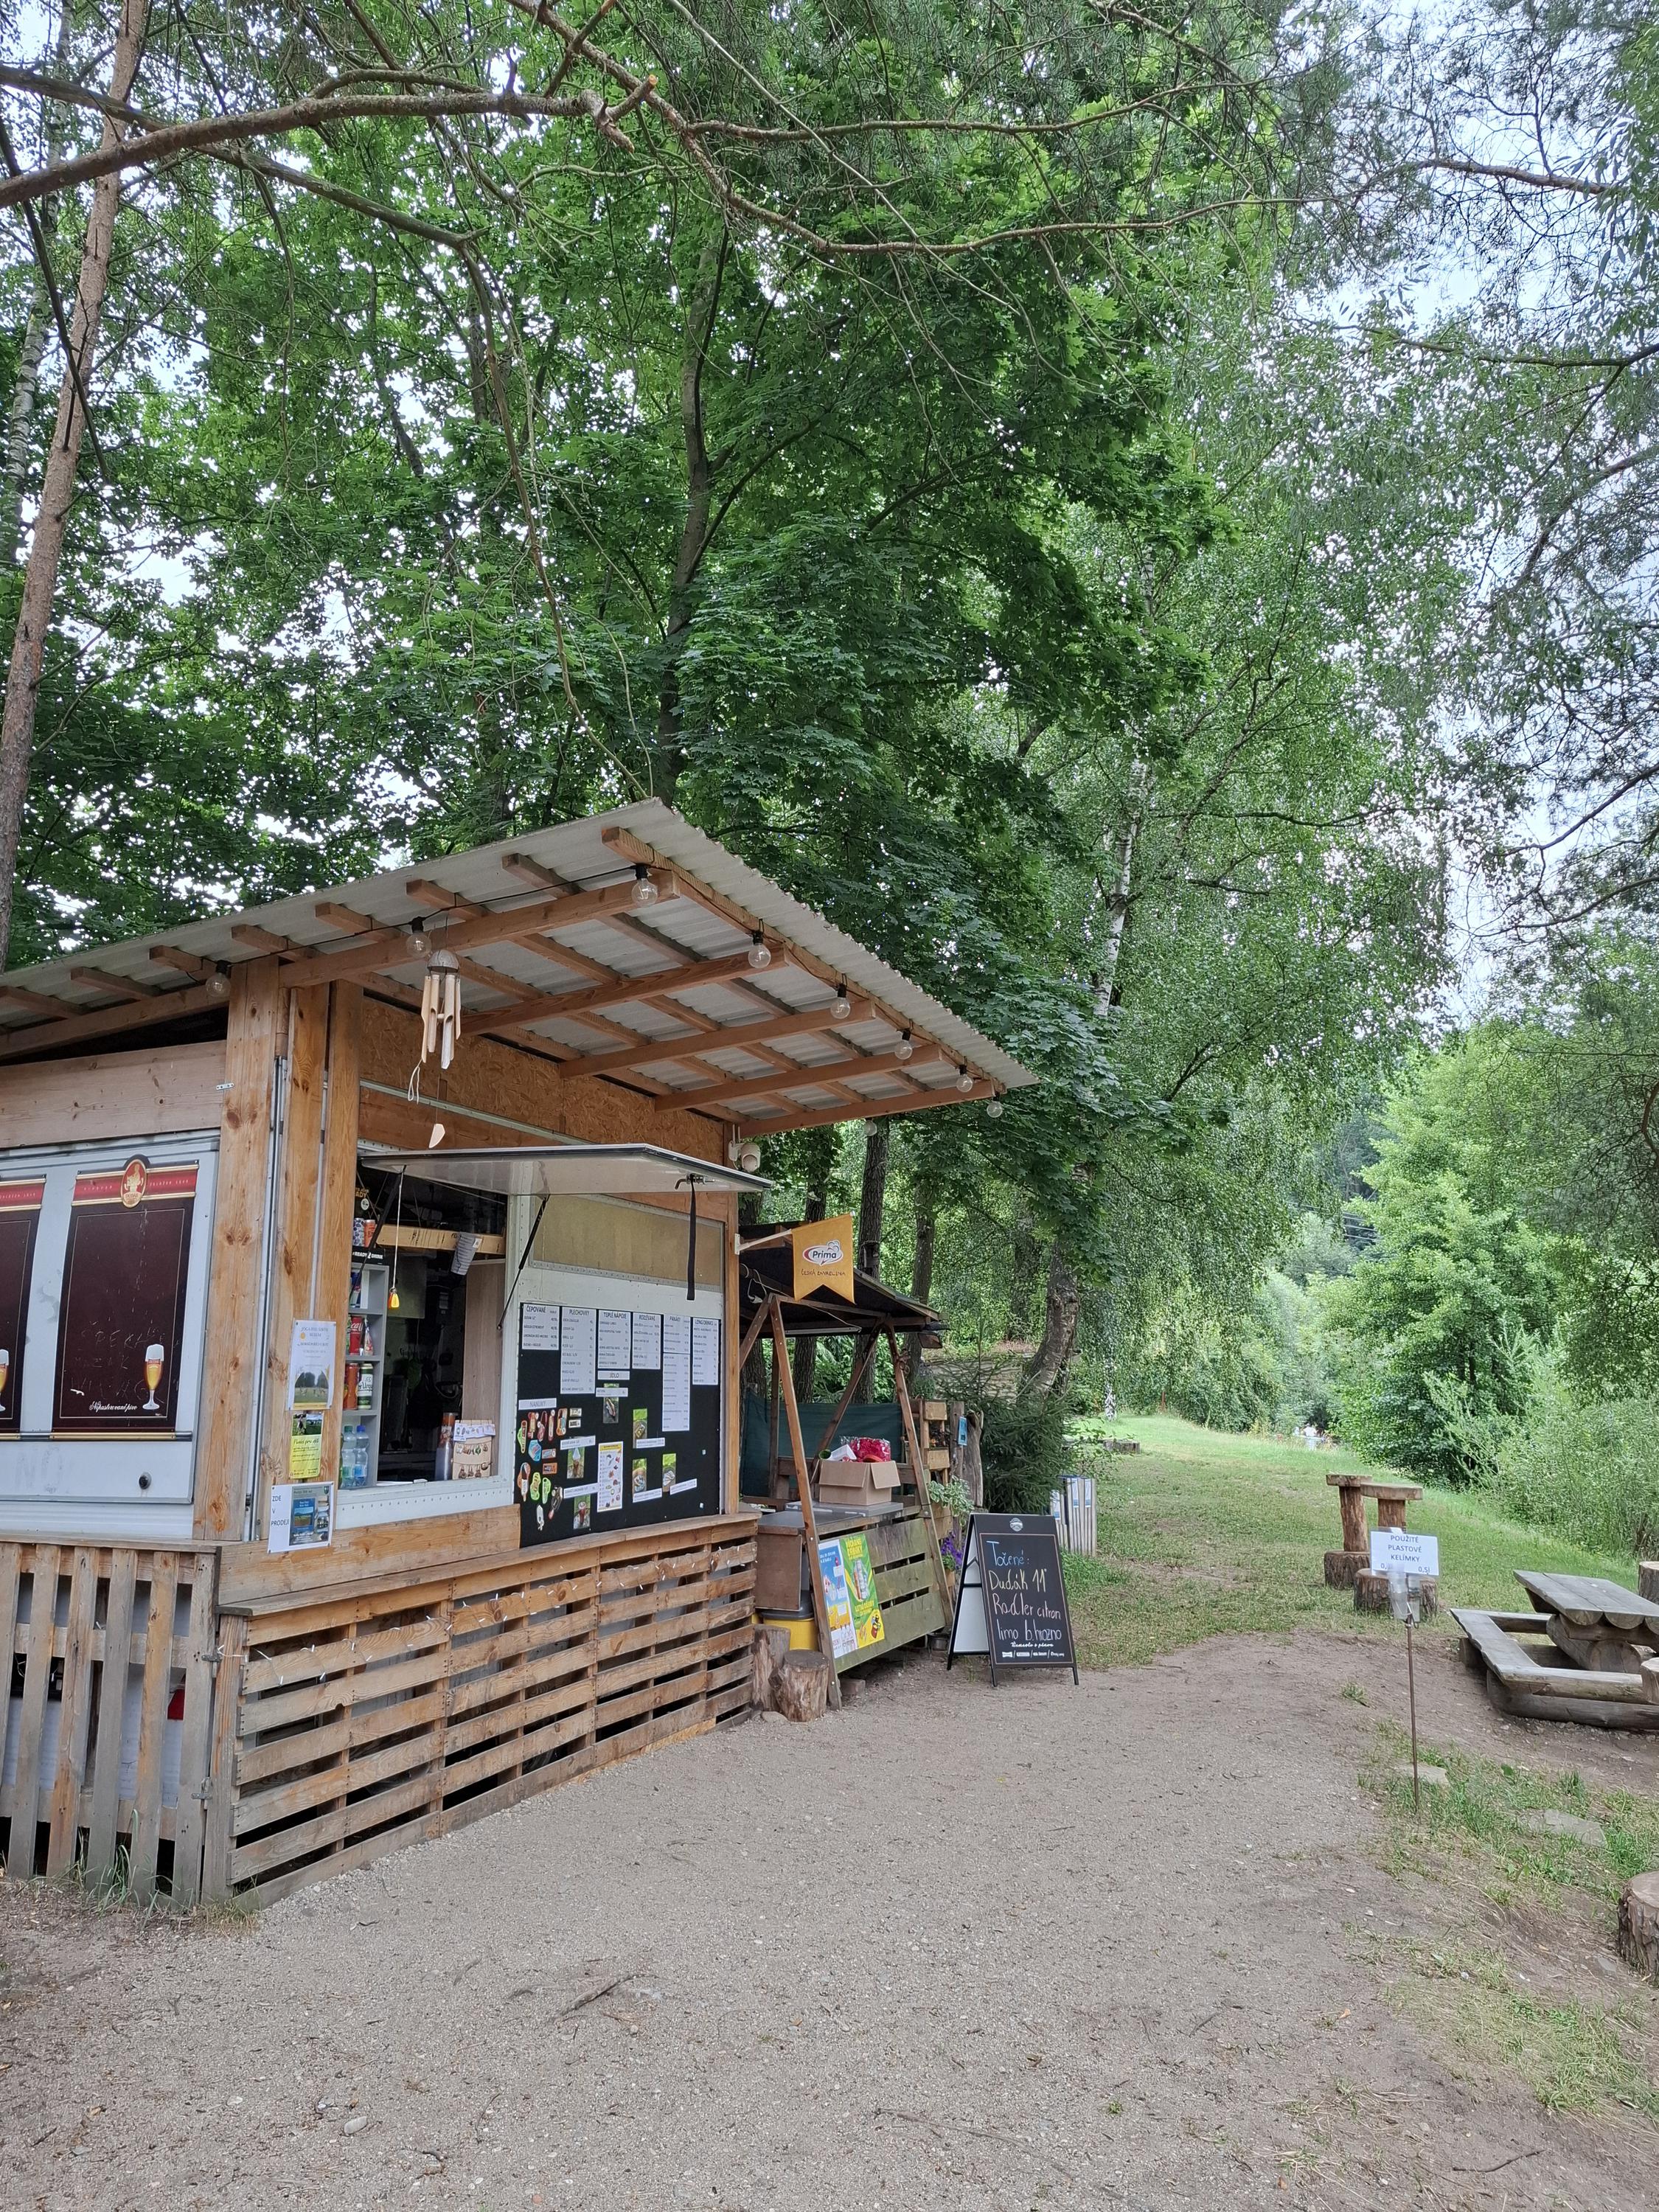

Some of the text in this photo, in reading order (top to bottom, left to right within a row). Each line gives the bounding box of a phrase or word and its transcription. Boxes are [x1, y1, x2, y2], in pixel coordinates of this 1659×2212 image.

[813, 1251, 837, 1259] Prima
[1388, 1544, 1422, 1553] PLASTOVÉ
[1391, 1554, 1420, 1562] KELÍMKY
[988, 1568, 1029, 1590] Dudák
[992, 1593, 1062, 1620] Radler citron
[997, 1618, 1019, 1641] limo
